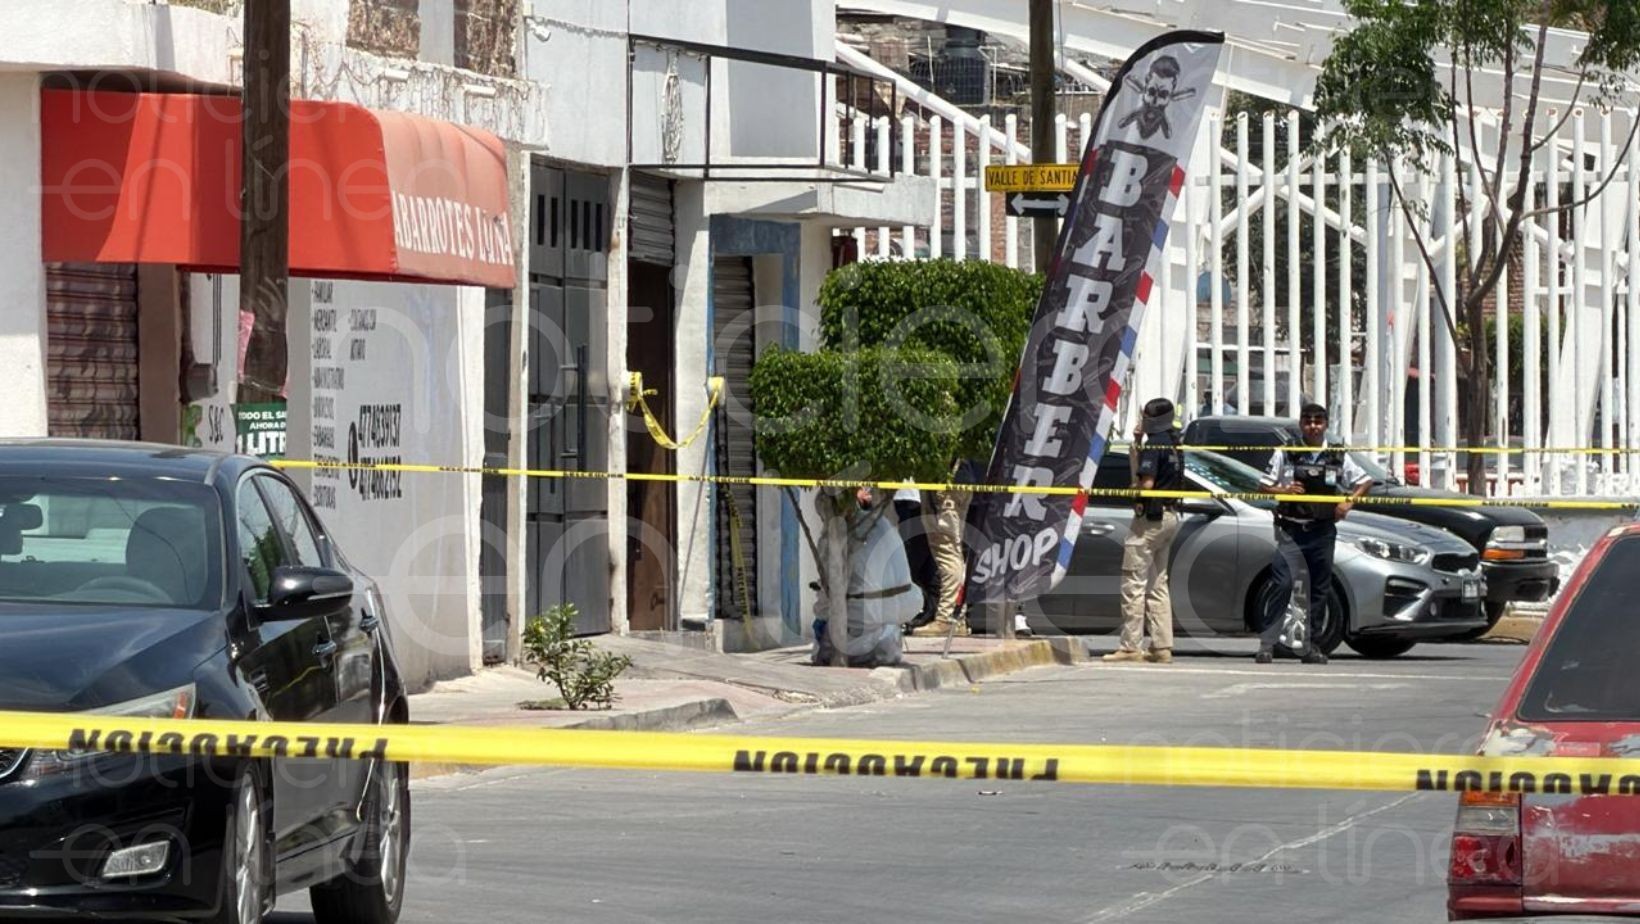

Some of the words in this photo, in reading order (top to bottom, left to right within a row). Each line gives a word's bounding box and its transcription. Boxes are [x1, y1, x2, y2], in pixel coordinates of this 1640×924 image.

[989, 170, 1017, 186] VALLE
[1022, 170, 1034, 185] DE
[1040, 169, 1078, 185] SANTIA
[391, 190, 475, 260] ABARROTES
[1002, 148, 1149, 522] BARBER
[249, 421, 280, 430] AHORA
[262, 411, 274, 419] EL
[246, 430, 287, 456] LITR
[971, 527, 1059, 584] SHOP
